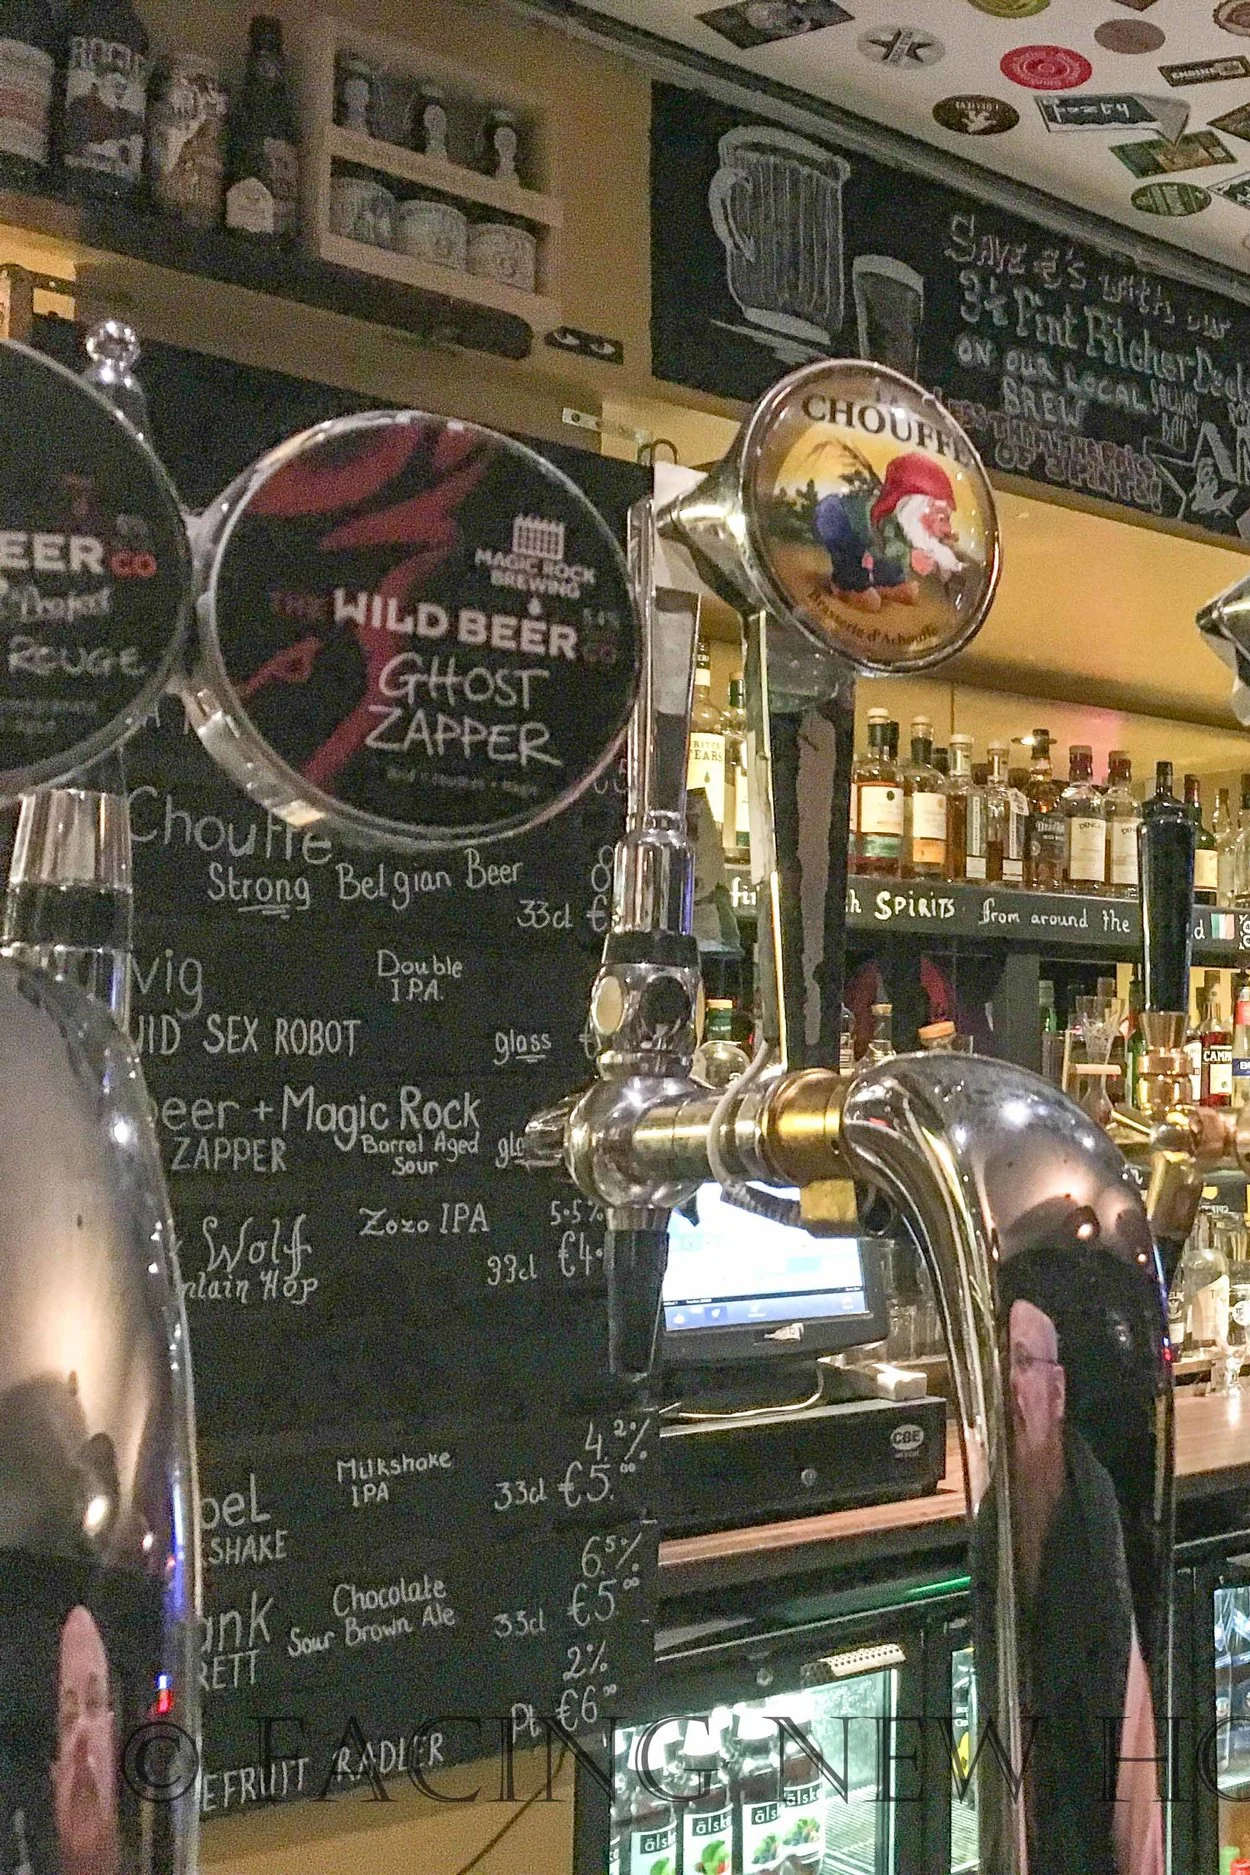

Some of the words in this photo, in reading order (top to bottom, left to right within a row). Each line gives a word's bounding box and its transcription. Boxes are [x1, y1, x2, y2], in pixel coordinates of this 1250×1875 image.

[1002, 375, 1087, 429] BREW
[475, 549, 540, 572] MAGIC
[332, 586, 451, 640] WILD
[456, 607, 580, 661] BEER
[378, 650, 551, 711] GHOST
[364, 703, 564, 768] ZAPPER
[207, 862, 311, 911] Strong
[335, 861, 451, 911] Belgian
[464, 846, 525, 891] Beer
[977, 898, 1020, 927] from
[1030, 907, 1089, 928] around
[1101, 908, 1132, 933] the
[376, 949, 464, 978] Double
[203, 1016, 260, 1056] SEX
[274, 1019, 362, 1057] ROBOT
[493, 1029, 553, 1066] glass
[282, 1085, 390, 1151] Magic
[400, 1085, 482, 1132] Rock
[170, 1137, 288, 1172] ZAPPER
[362, 1134, 424, 1156] Barrel
[435, 1136, 480, 1162] Aged
[391, 1158, 438, 1176] Sour
[201, 1213, 313, 1273] Wolf
[440, 1203, 491, 1234] IPA
[262, 1269, 319, 1305] Hop
[336, 1450, 452, 1485] Milkshake
[351, 1482, 390, 1507] IPA
[209, 1529, 289, 1567] SHAKE
[332, 1575, 448, 1618] Chocolate
[287, 1631, 336, 1658] Sour
[344, 1615, 413, 1648] Brown
[421, 1603, 456, 1629] Ale
[335, 1731, 445, 1783] RADLER
